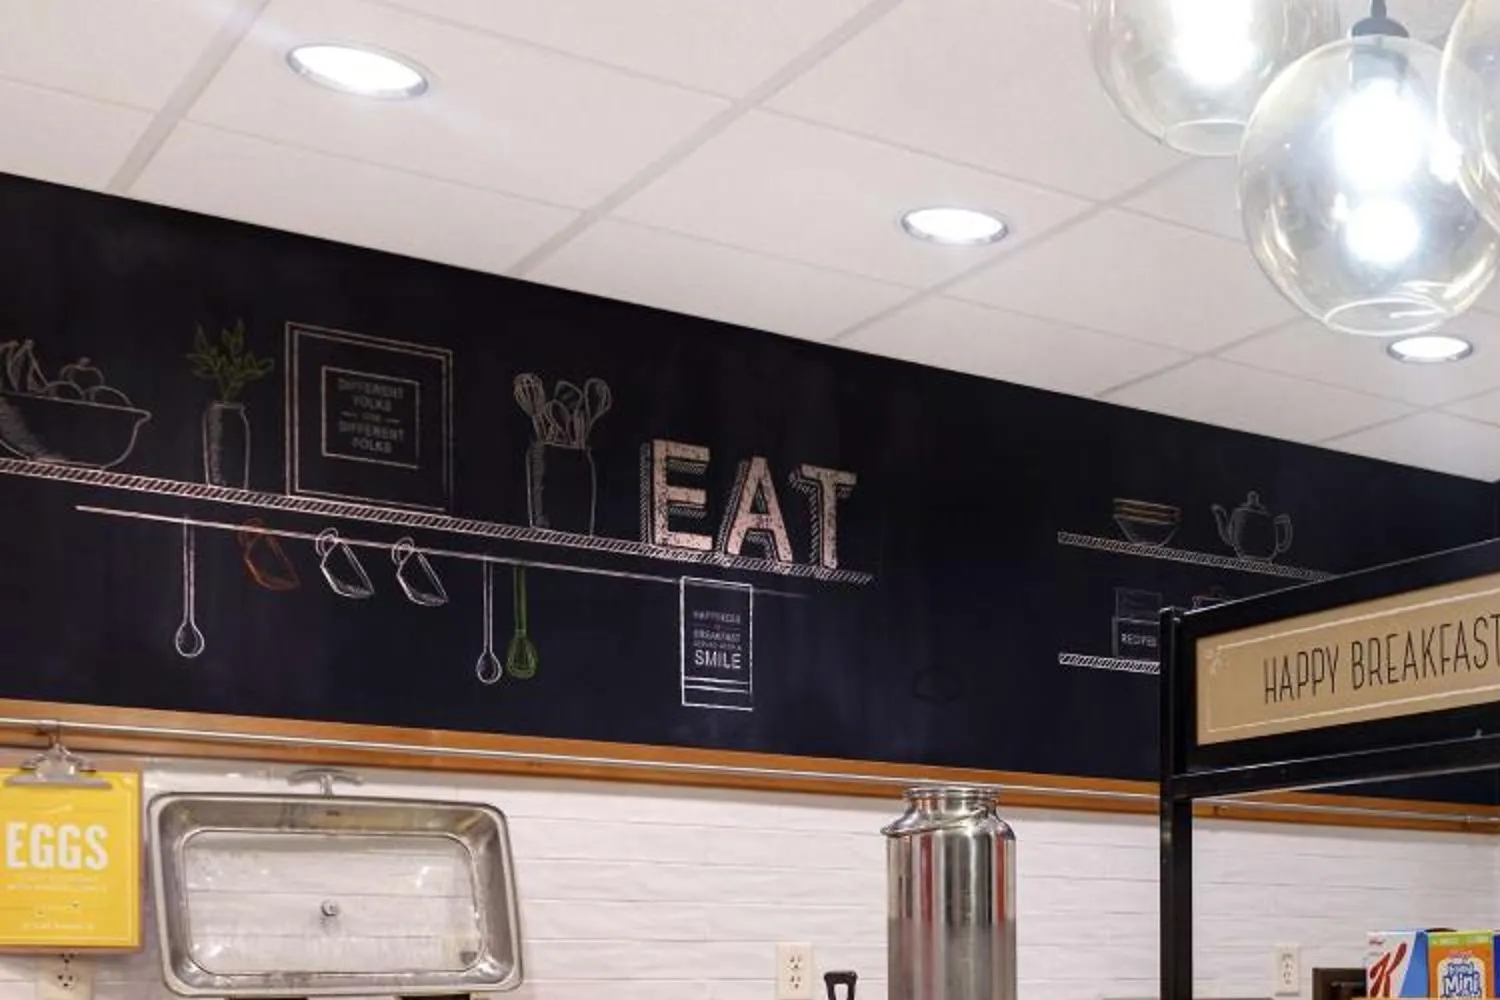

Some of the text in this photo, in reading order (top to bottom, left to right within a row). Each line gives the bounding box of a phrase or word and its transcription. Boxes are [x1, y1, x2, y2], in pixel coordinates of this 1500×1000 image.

[640, 439, 857, 570] EAT
[695, 649, 741, 669] SMILE
[1263, 649, 1338, 704] HAPPY
[6, 821, 109, 870] EGGS
[1444, 971, 1481, 998] Mini
